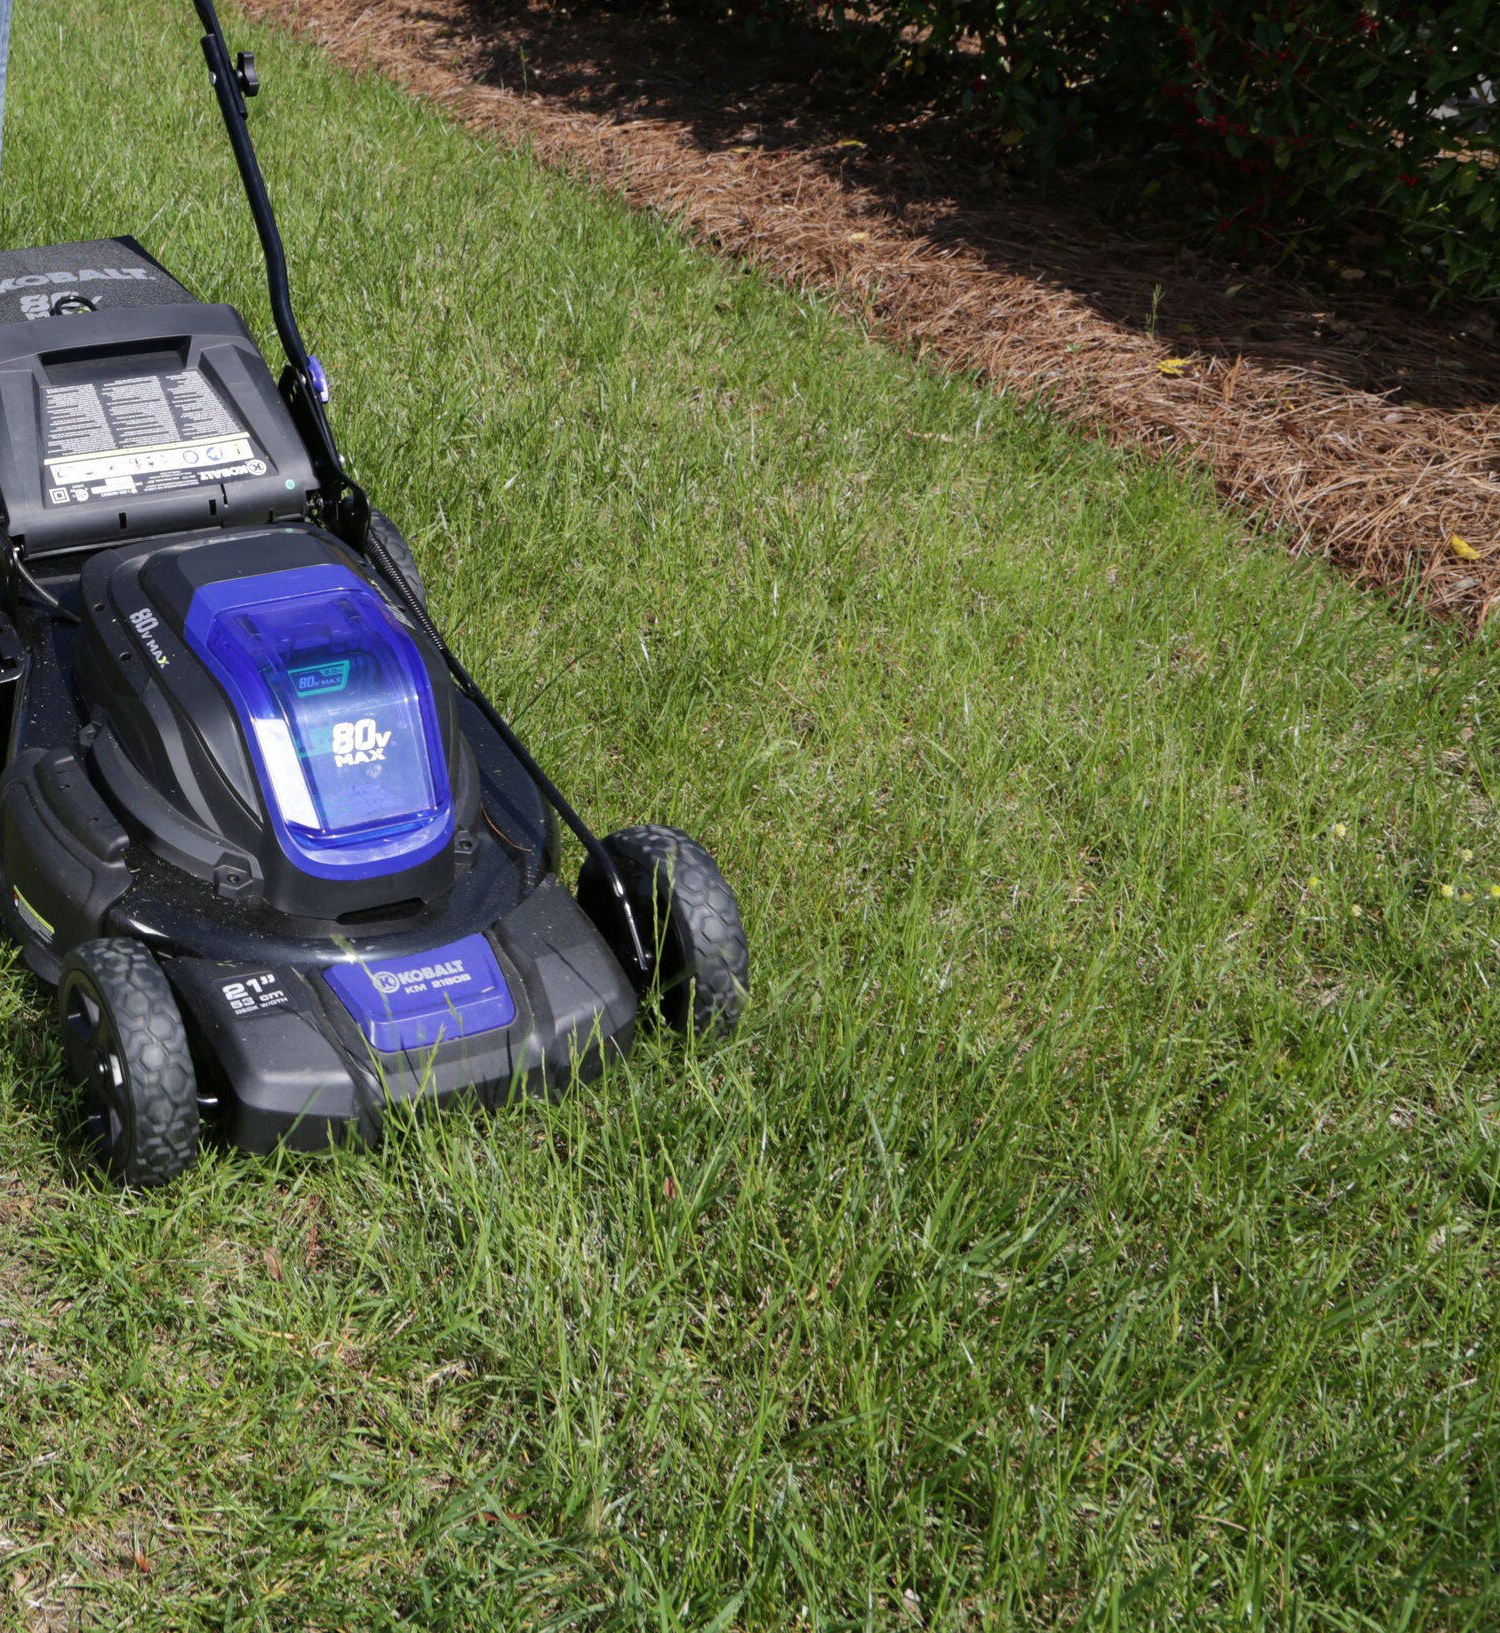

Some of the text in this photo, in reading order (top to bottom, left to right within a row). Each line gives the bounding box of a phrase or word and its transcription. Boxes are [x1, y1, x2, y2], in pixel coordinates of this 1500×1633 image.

[199, 464, 248, 480] KOBALT
[146, 639, 170, 669] MAX
[334, 747, 386, 768] MAX
[396, 960, 465, 985] KOBALT
[404, 983, 428, 995] KM
[230, 990, 284, 1010] 53 cm
[234, 996, 289, 1015] DECK WIDTH
